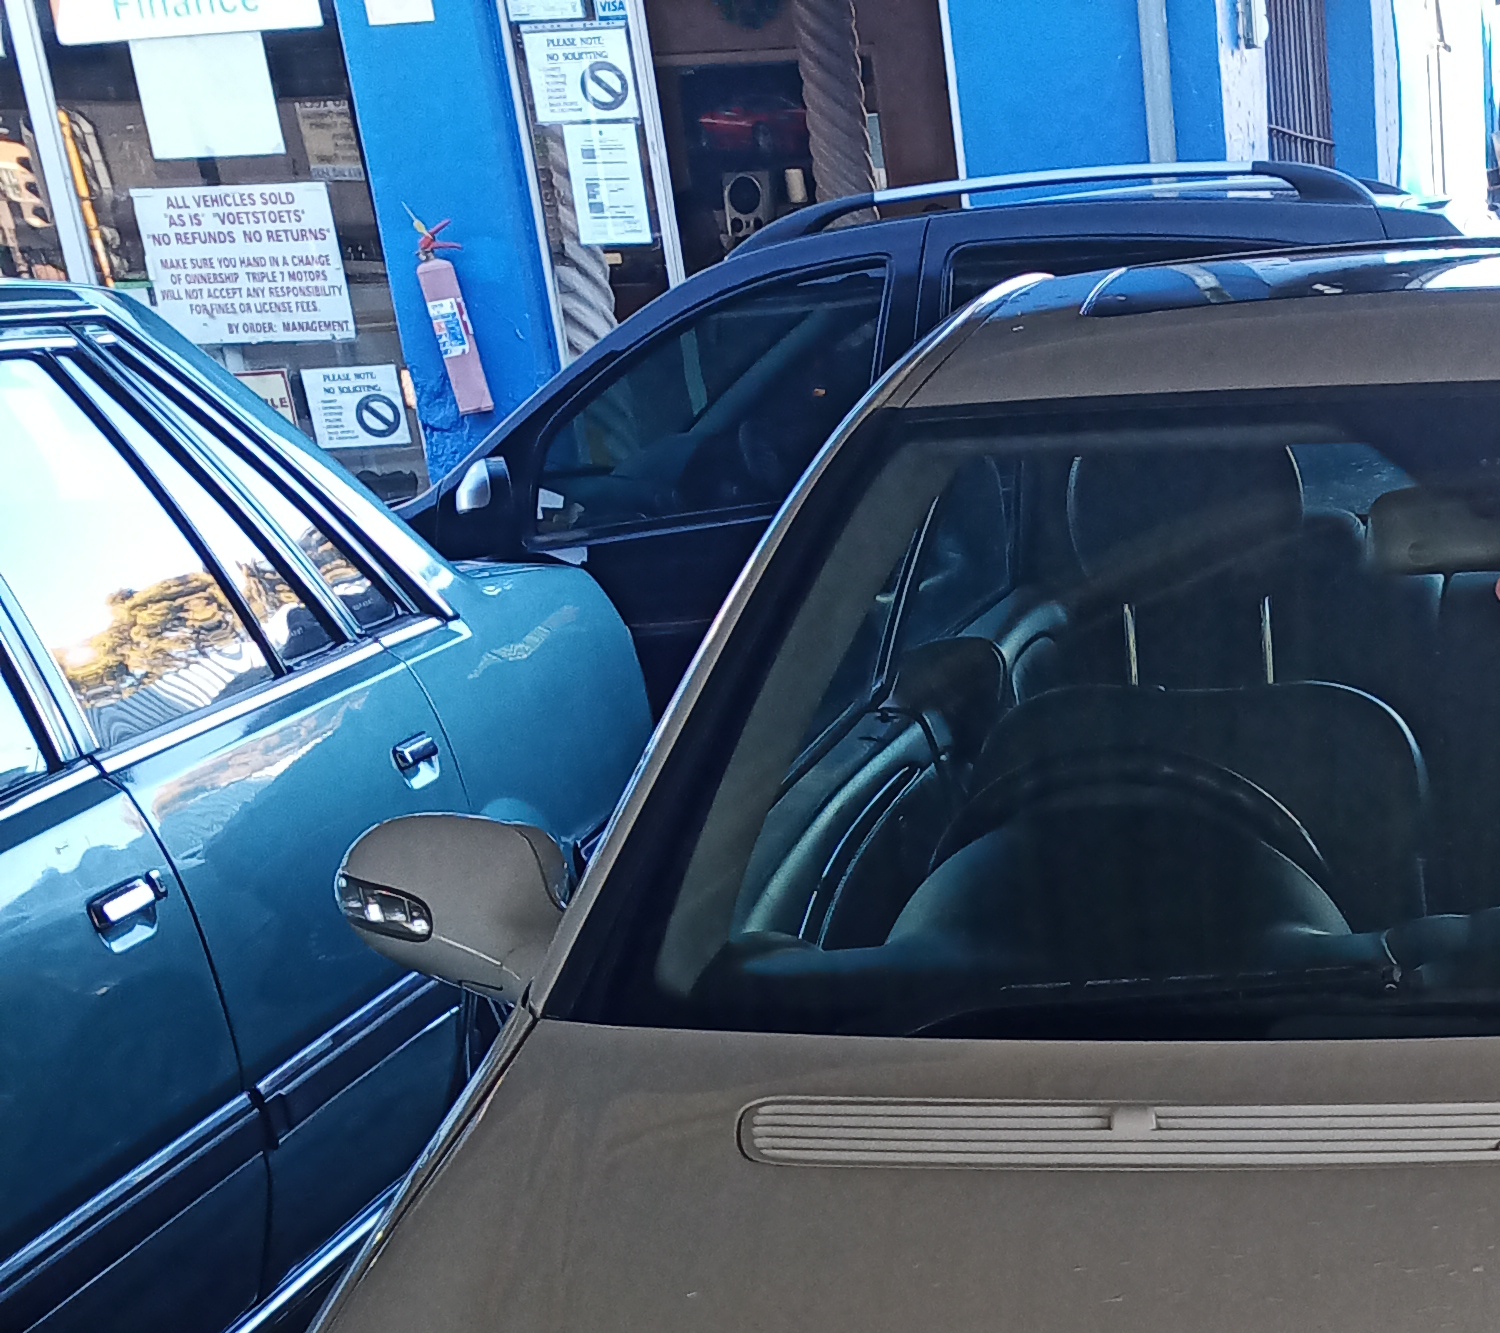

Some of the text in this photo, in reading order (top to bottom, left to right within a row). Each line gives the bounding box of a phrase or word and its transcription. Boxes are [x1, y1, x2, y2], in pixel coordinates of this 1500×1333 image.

[546, 53, 559, 61] NO
[166, 191, 295, 210] ALL VEHICLES SOLD
[175, 230, 236, 246] REFUNDS
[243, 230, 263, 244] NO
[160, 254, 331, 270] MAKE SURE YOU HAND IN A CHANGE
[170, 270, 328, 286] OF OWNERSHIP TRIPLE 7 MOTORS
[160, 285, 343, 301] WILL NOT ACCEPT ANY RESPONSIBILITY
[189, 303, 209, 316] FOR
[210, 302, 237, 315] FINES
[239, 301, 253, 314] OR
[254, 301, 293, 314] LICENSE
[227, 323, 240, 335] BY
[282, 320, 349, 333] MANAGEMENT
